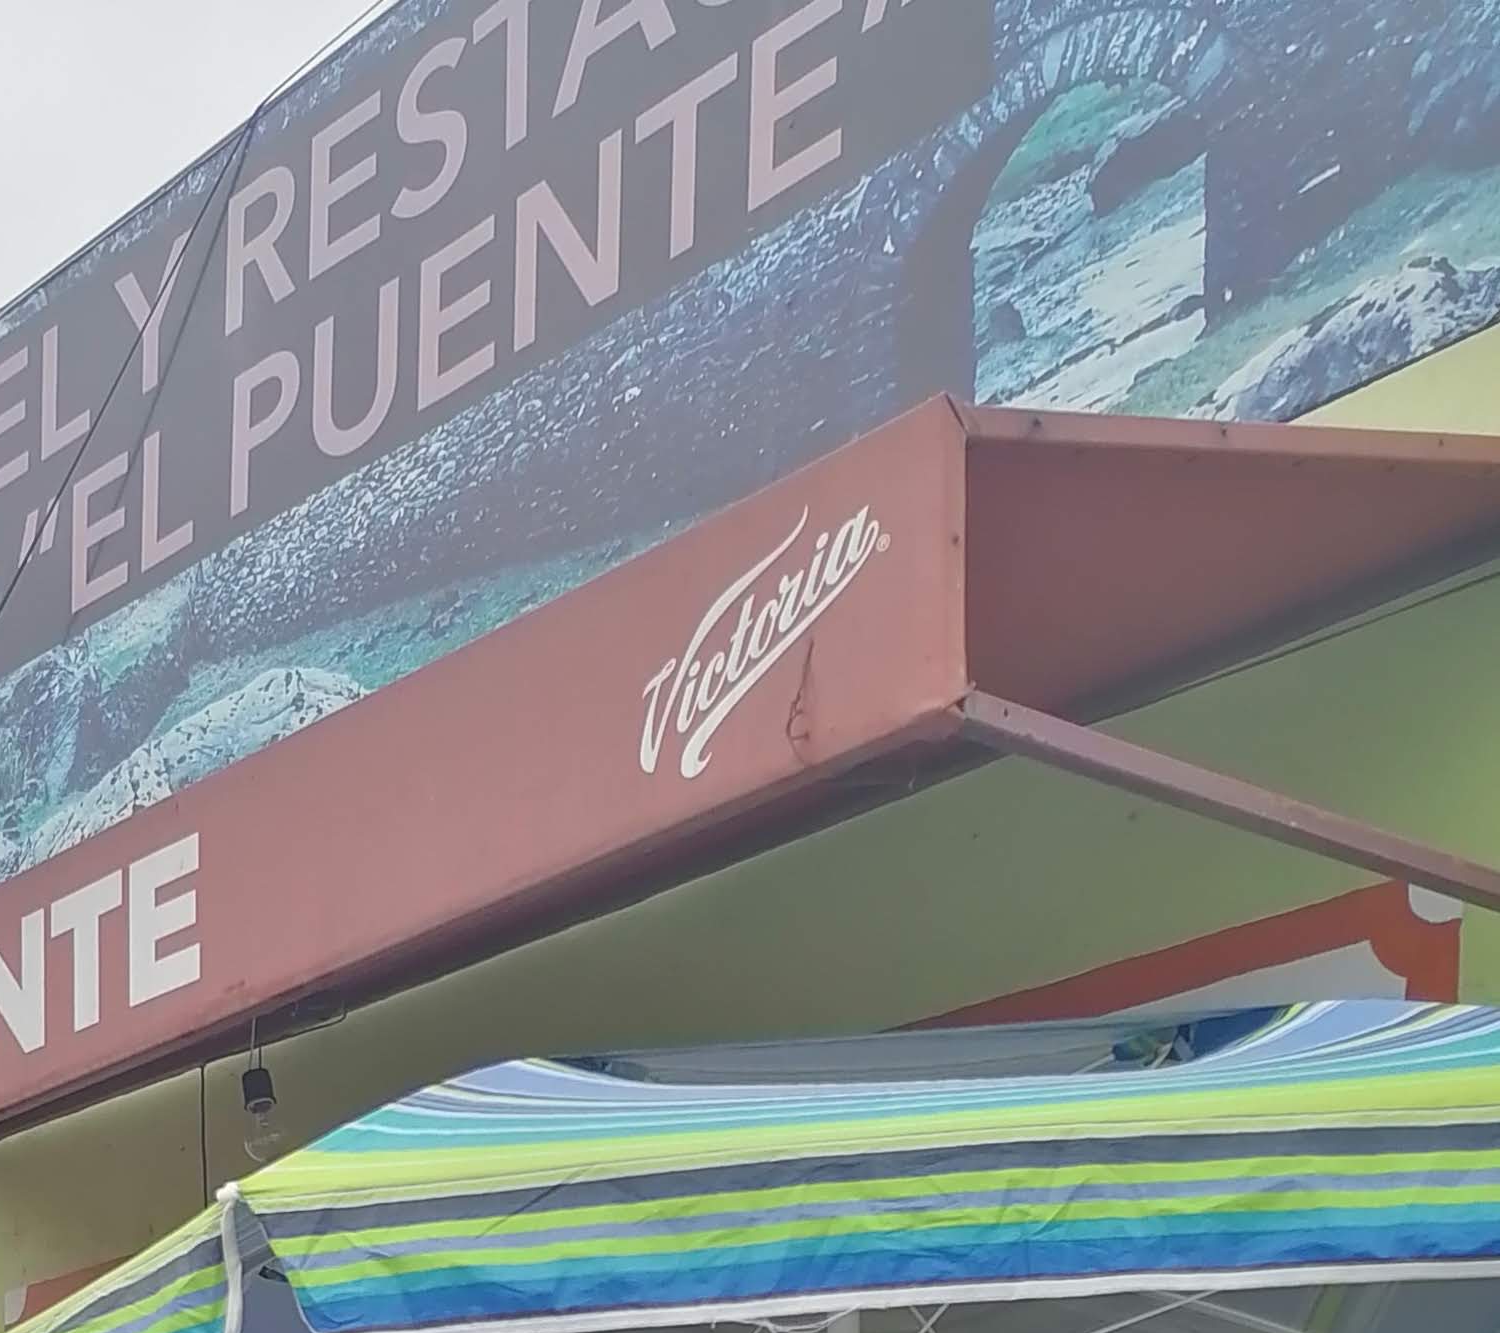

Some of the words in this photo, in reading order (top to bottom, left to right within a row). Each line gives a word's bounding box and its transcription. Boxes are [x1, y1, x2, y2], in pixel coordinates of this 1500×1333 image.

[114, 235, 189, 395] Y
[223, 0, 738, 338] RESTA
[639, 504, 882, 779] Victoria
